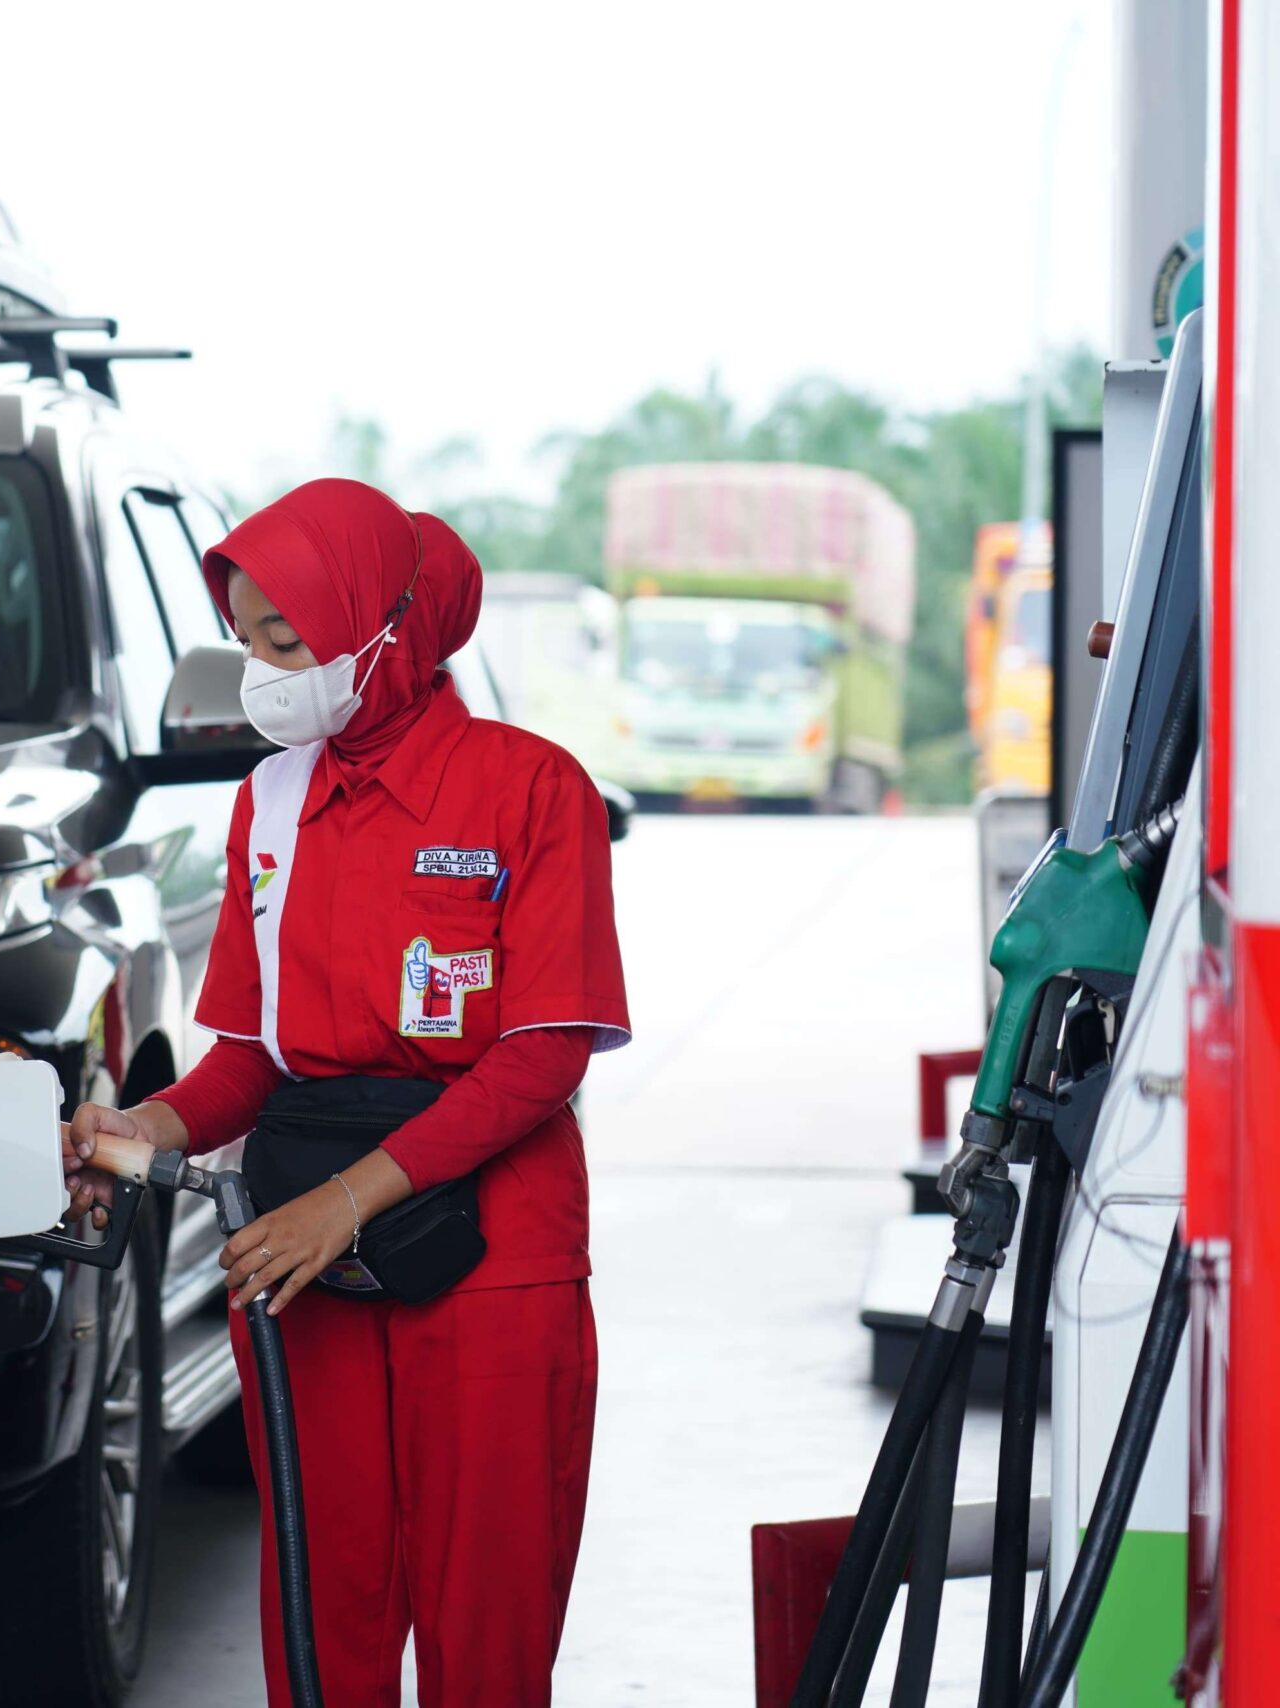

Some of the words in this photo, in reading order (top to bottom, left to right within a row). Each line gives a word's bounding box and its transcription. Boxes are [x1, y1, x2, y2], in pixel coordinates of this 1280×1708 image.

[423, 852, 452, 861] DIVA
[450, 954, 488, 973] PASTI
[453, 971, 485, 988] PAS!
[417, 1019, 458, 1028] PERTAMINA
